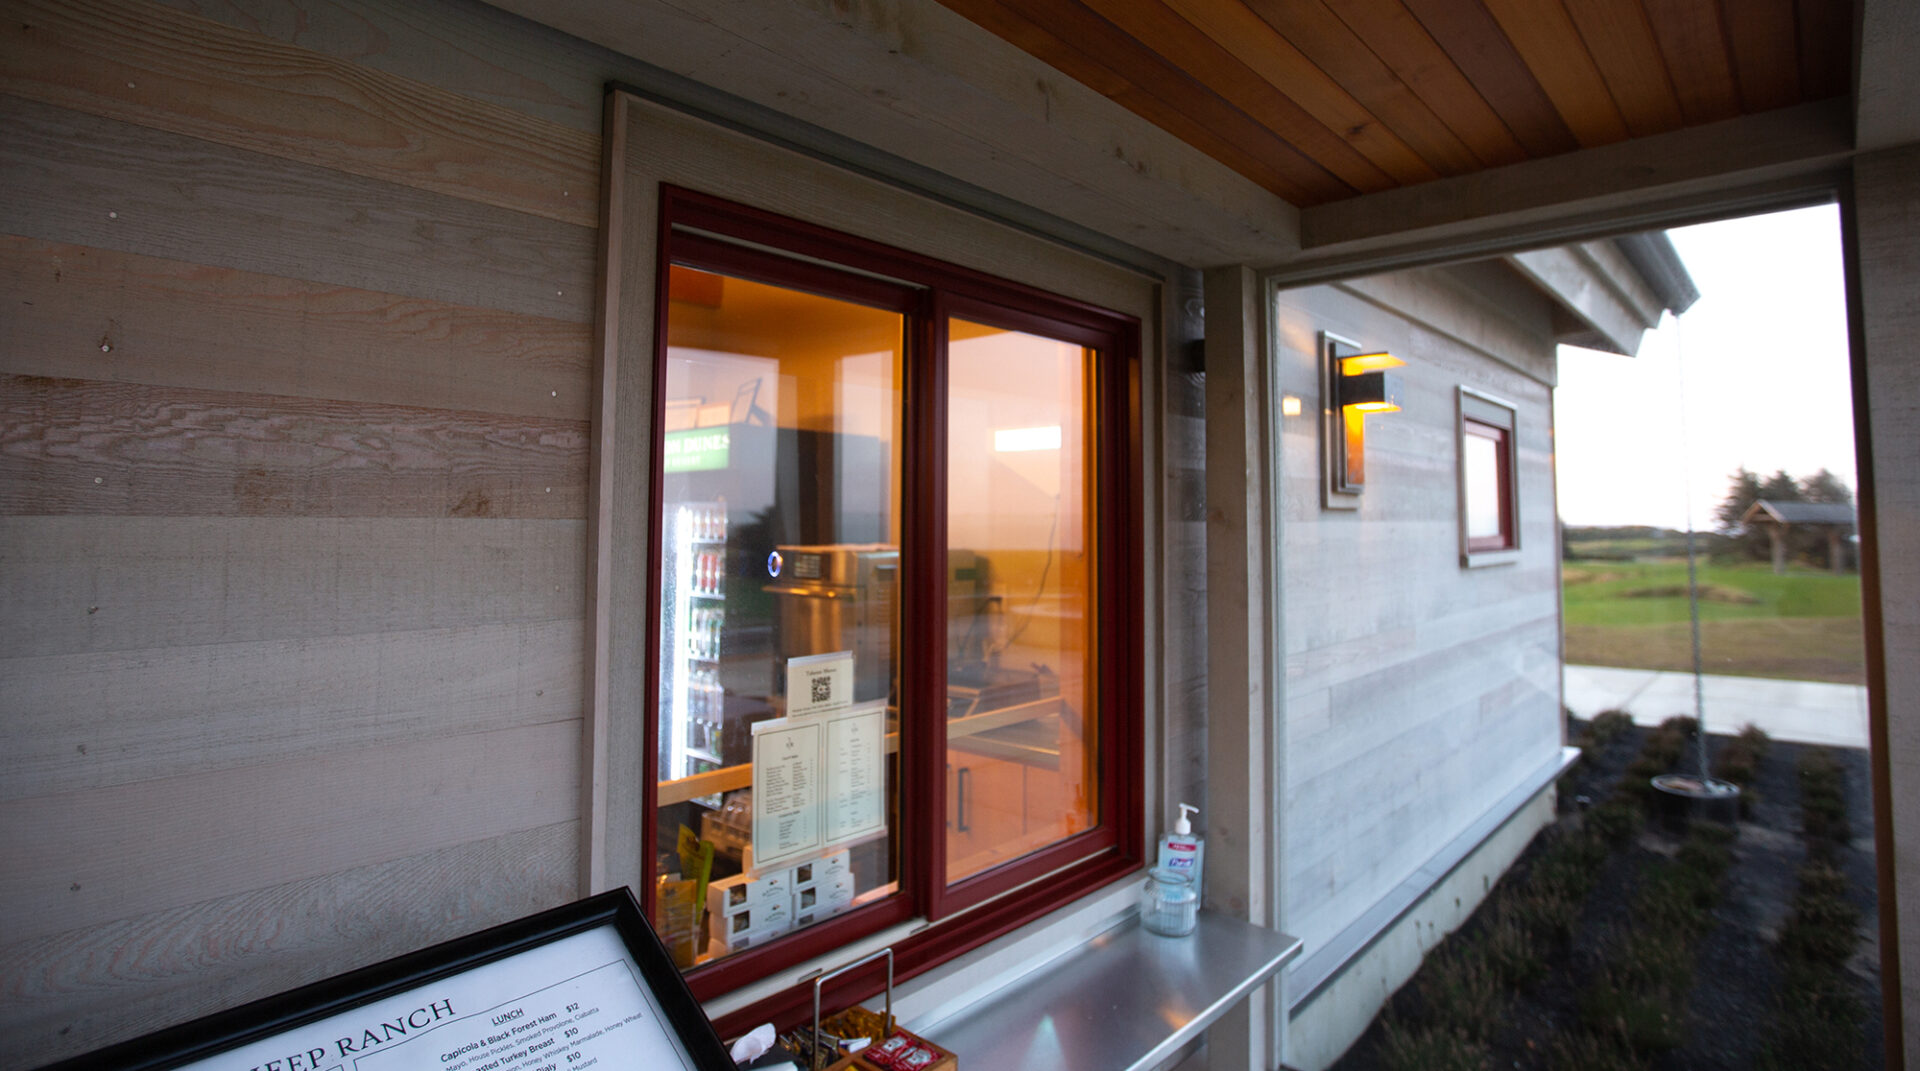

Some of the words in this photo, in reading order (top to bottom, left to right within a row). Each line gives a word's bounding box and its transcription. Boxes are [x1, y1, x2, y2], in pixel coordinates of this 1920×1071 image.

[250, 1047, 325, 1071] EEP
[334, 999, 456, 1058] RANCH
[440, 1041, 479, 1063] Capicola
[480, 1039, 487, 1047] &
[488, 1031, 511, 1045] Black
[511, 1019, 538, 1036] Forest
[538, 1012, 557, 1024] Ham
[565, 1002, 580, 1013] $12
[468, 1051, 490, 1063] House
[490, 1042, 515, 1057] Pickles,
[515, 1030, 543, 1045] Smoked
[542, 1017, 575, 1036] Provolone,
[574, 1006, 599, 1020] Ciabatta
[491, 1008, 525, 1026] LUNCH
[521, 1056, 543, 1068] Honey
[543, 1044, 570, 1060] Whiskey
[569, 1029, 605, 1048] Marmalade,
[604, 1020, 624, 1033] Honey
[623, 1012, 643, 1024] Wheat
[500, 1048, 528, 1065] Turkey
[528, 1037, 555, 1053] Breast
[564, 1026, 579, 1039] $10
[566, 1050, 581, 1063] $10
[572, 1057, 598, 1071] Mustard
